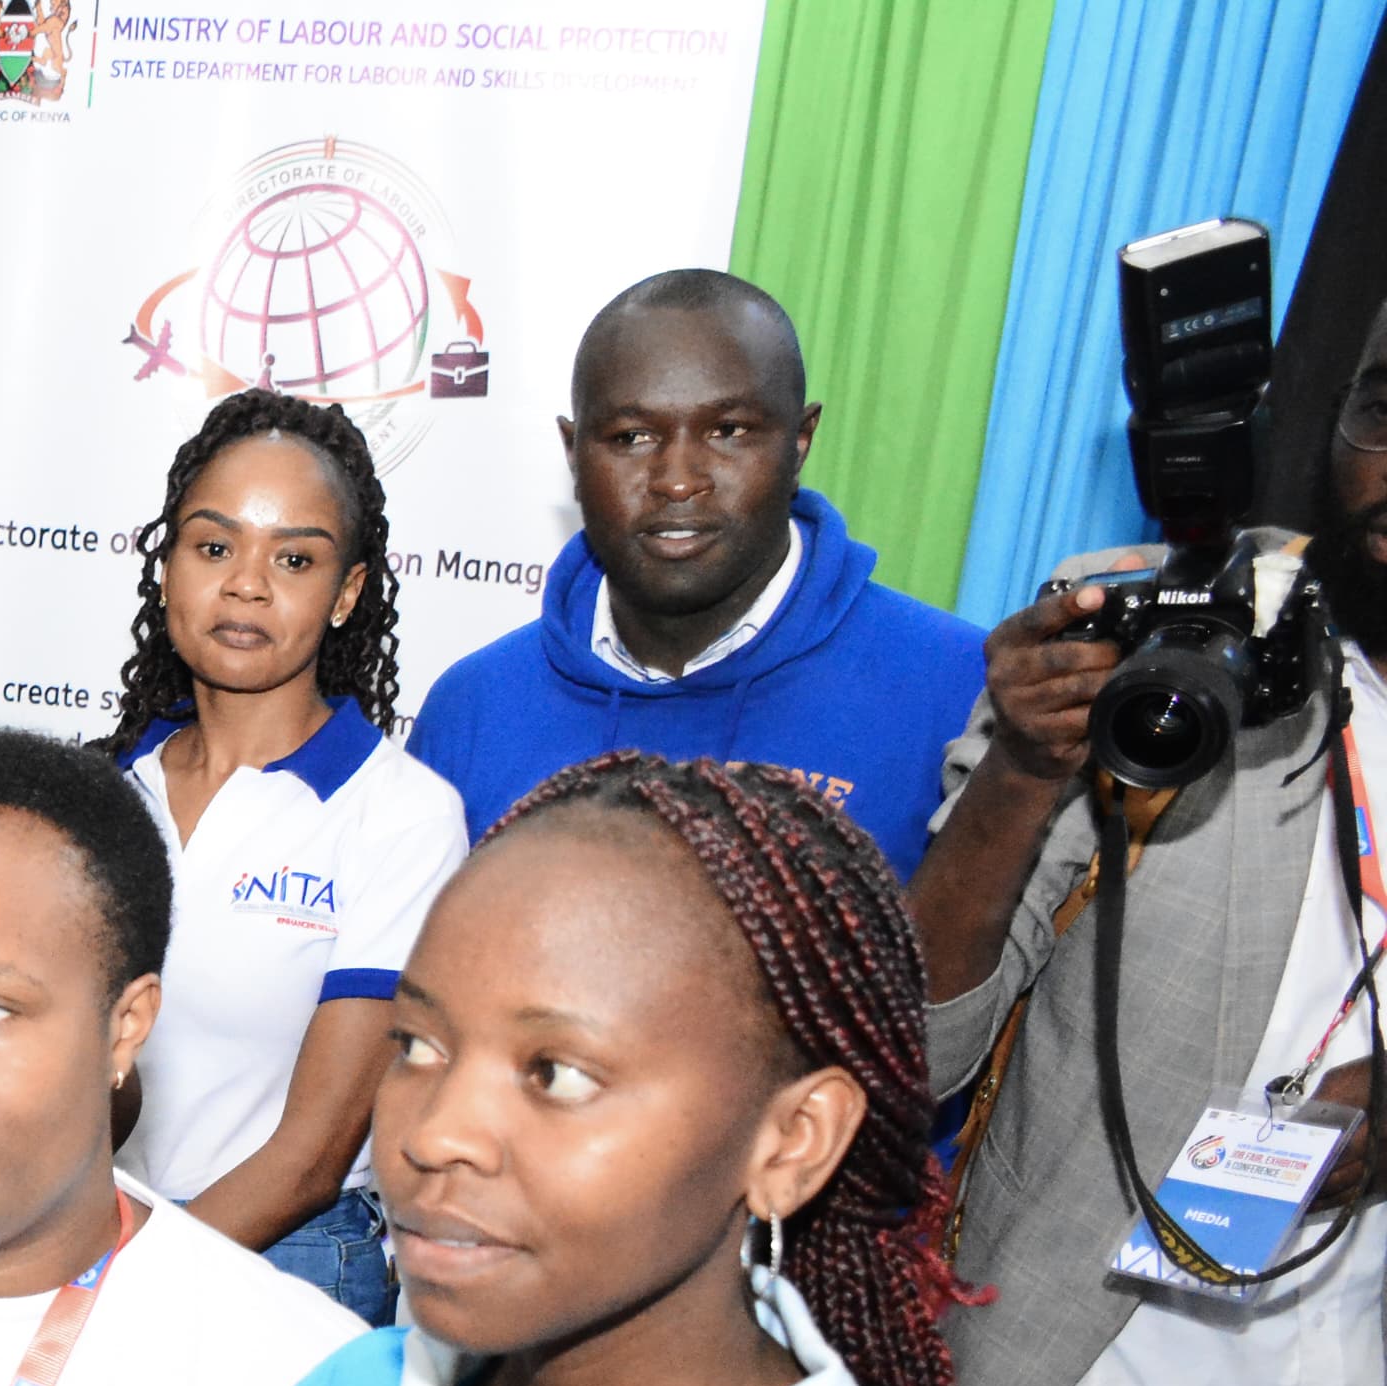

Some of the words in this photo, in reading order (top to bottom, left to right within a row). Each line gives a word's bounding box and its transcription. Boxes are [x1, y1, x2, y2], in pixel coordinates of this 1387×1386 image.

[113, 17, 228, 42] MINISTRY
[236, 18, 271, 44] OF
[279, 19, 383, 47] LABOUR
[390, 22, 447, 49] AND
[456, 23, 549, 51] SOCIAL
[559, 26, 729, 57] PROTECTION
[110, 60, 167, 80] STATE
[172, 61, 298, 84] DEPARTMENT
[303, 63, 342, 85] FOR
[348, 65, 428, 89] LABOUR
[433, 67, 476, 89] AND
[480, 68, 547, 91] SKILLS
[11, 110, 27, 122] OF
[30, 111, 71, 123] KENYA
[223, 164, 337, 222] DIRECTORATE
[343, 167, 366, 186] OF
[370, 179, 427, 240] LABOUR
[110, 526, 145, 555] of
[435, 549, 544, 595] Manag
[1157, 590, 1211, 605] Nikon
[3, 681, 90, 709] create
[1183, 1208, 1231, 1228] MEDIA
